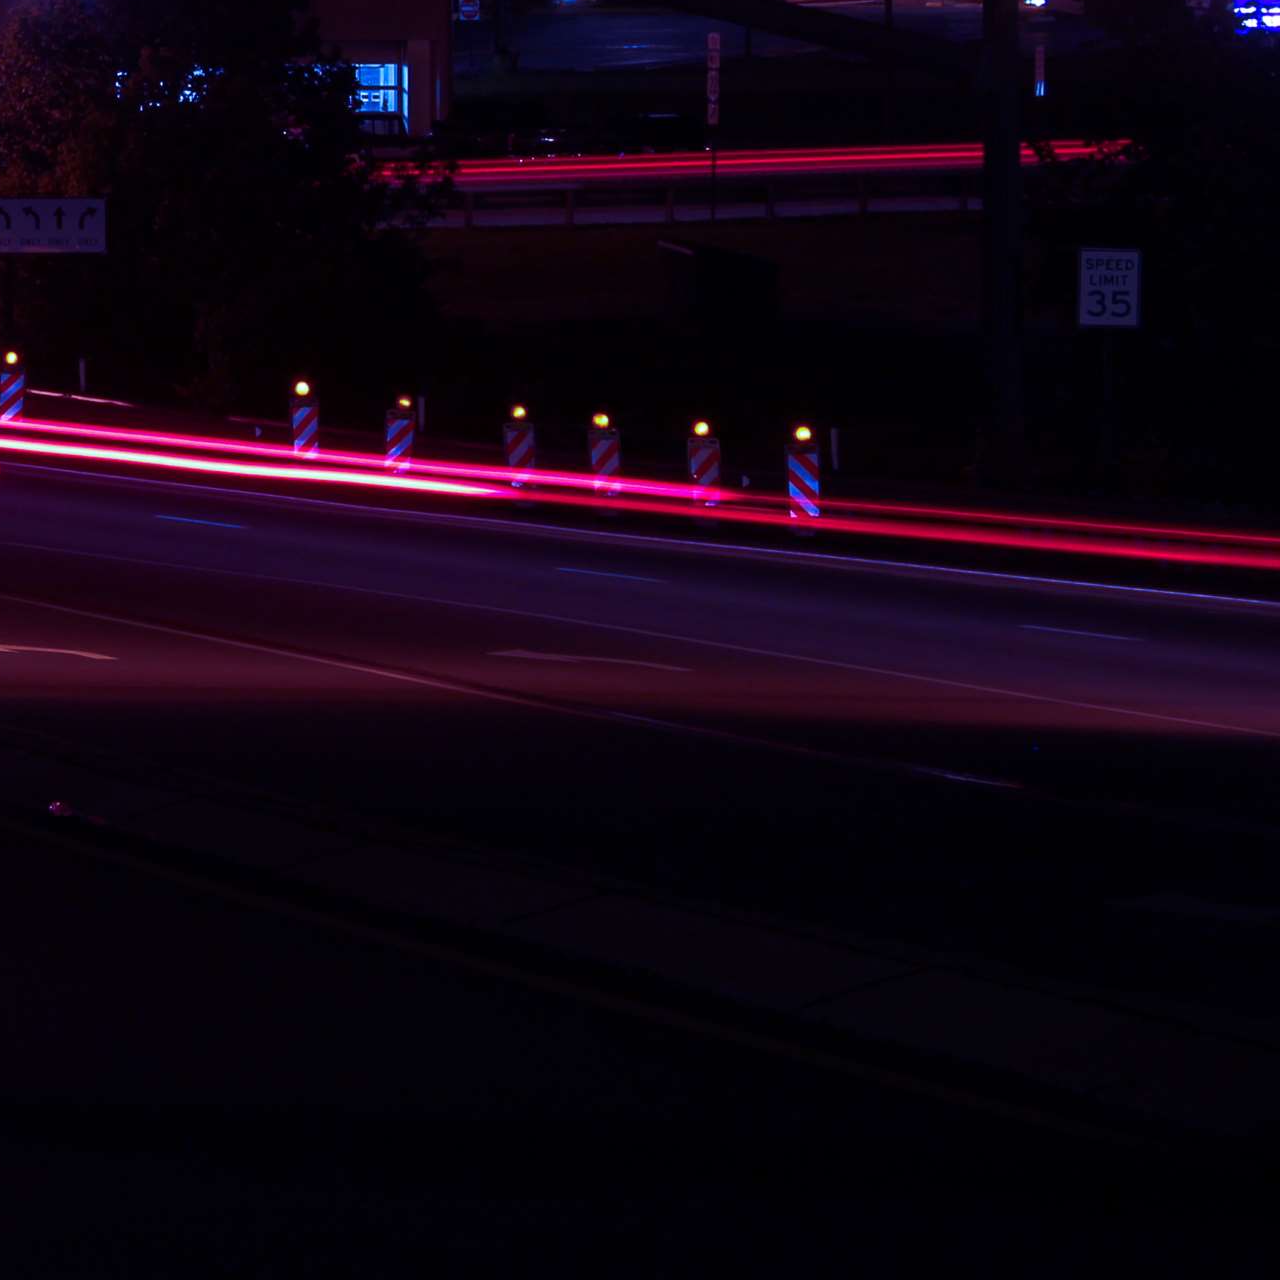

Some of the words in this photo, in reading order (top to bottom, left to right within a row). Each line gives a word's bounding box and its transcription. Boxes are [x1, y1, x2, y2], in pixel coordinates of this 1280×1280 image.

[1086, 258, 1135, 271] SPEED
[1089, 274, 1129, 287] LIMIT
[1087, 290, 1131, 317] 35
